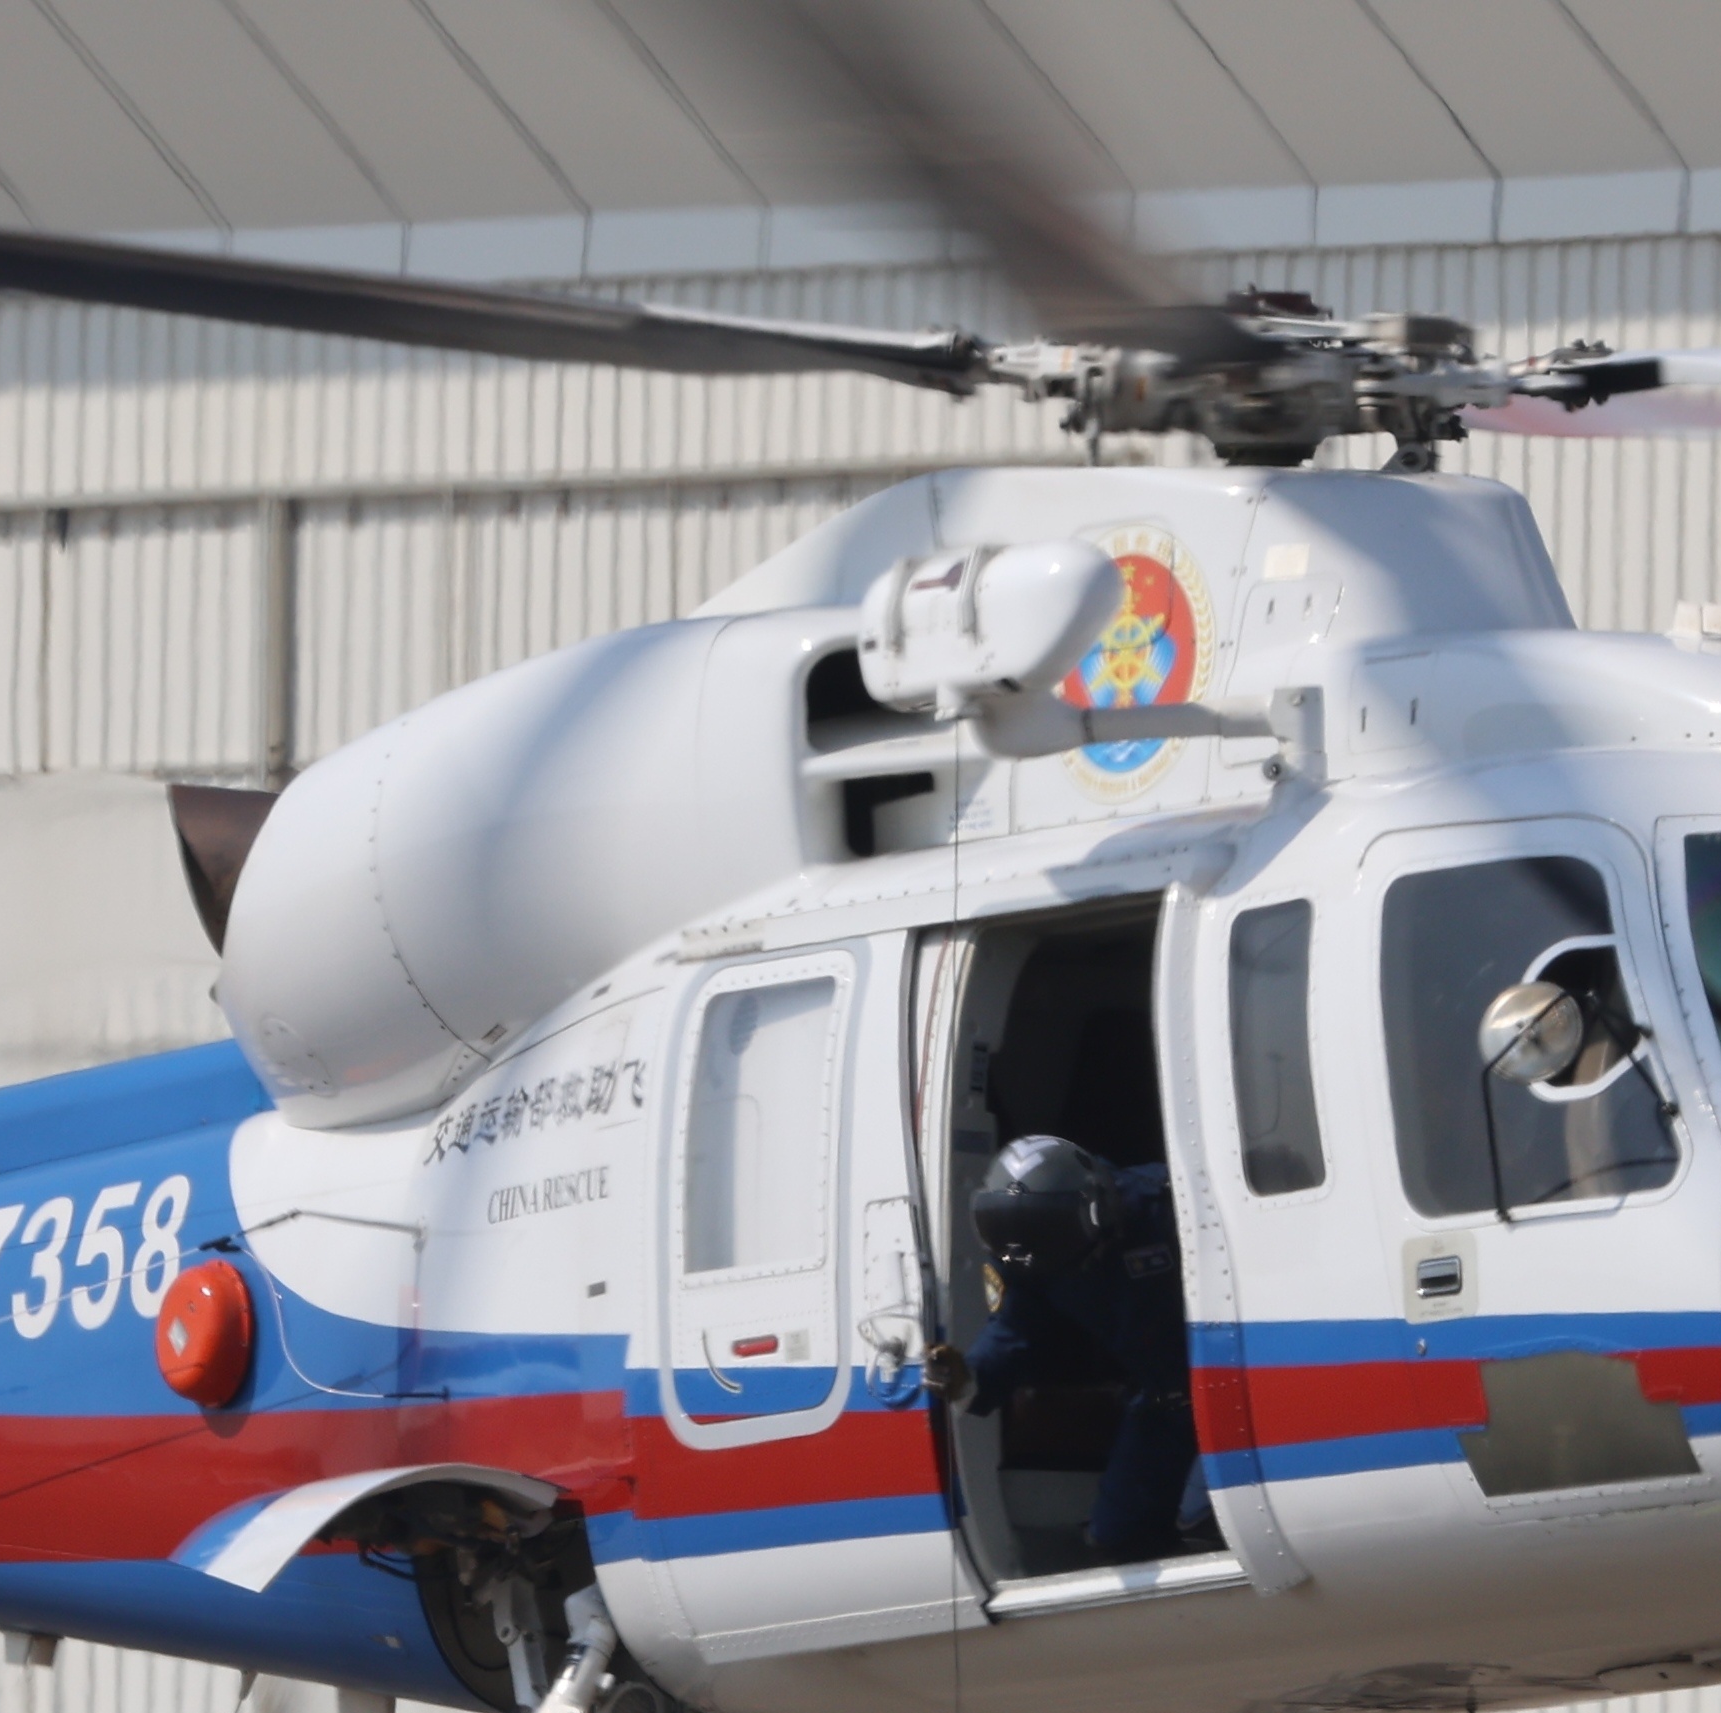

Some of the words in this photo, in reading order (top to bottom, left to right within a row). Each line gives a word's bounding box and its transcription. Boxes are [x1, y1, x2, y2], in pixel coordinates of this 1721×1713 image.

[423, 1058, 646, 1166] 交通运输部救助飞
[487, 1184, 539, 1225] CHINA
[542, 1166, 608, 1211] RESCUE
